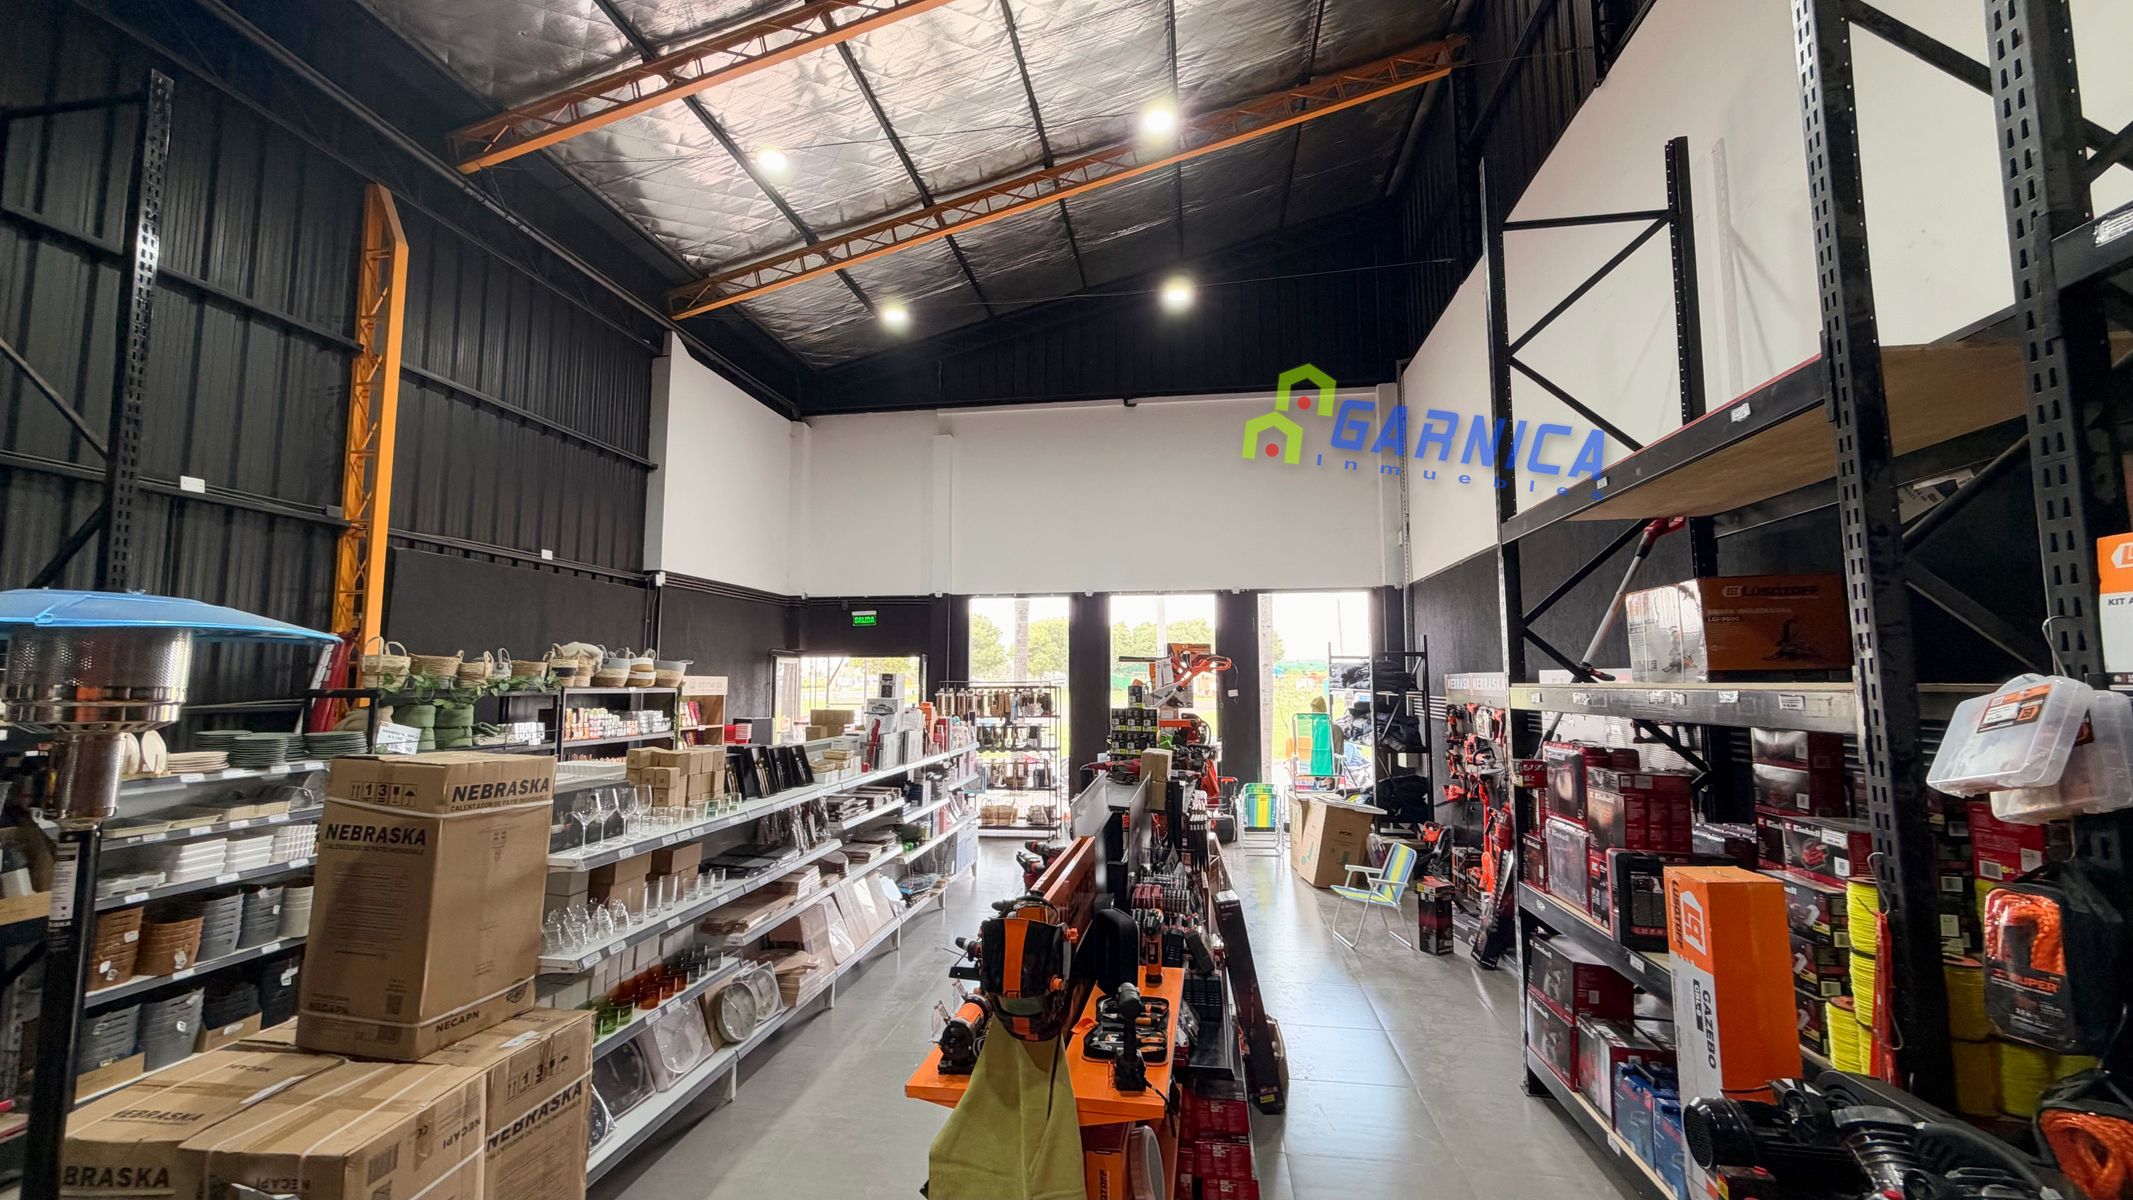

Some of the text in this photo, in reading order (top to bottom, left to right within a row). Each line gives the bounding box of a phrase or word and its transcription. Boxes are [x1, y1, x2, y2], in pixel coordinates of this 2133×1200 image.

[2108, 597, 2126, 606] KIT
[854, 616, 875, 624] SALIDA
[452, 777, 549, 803] NEBRASKA
[325, 823, 427, 846] NEBRASKA
[1671, 880, 1684, 950] LUSQTOFF
[435, 1010, 480, 1033] NECAPN
[1702, 989, 1717, 1070] GAZEBO
[63, 1165, 170, 1188] BRASKA
